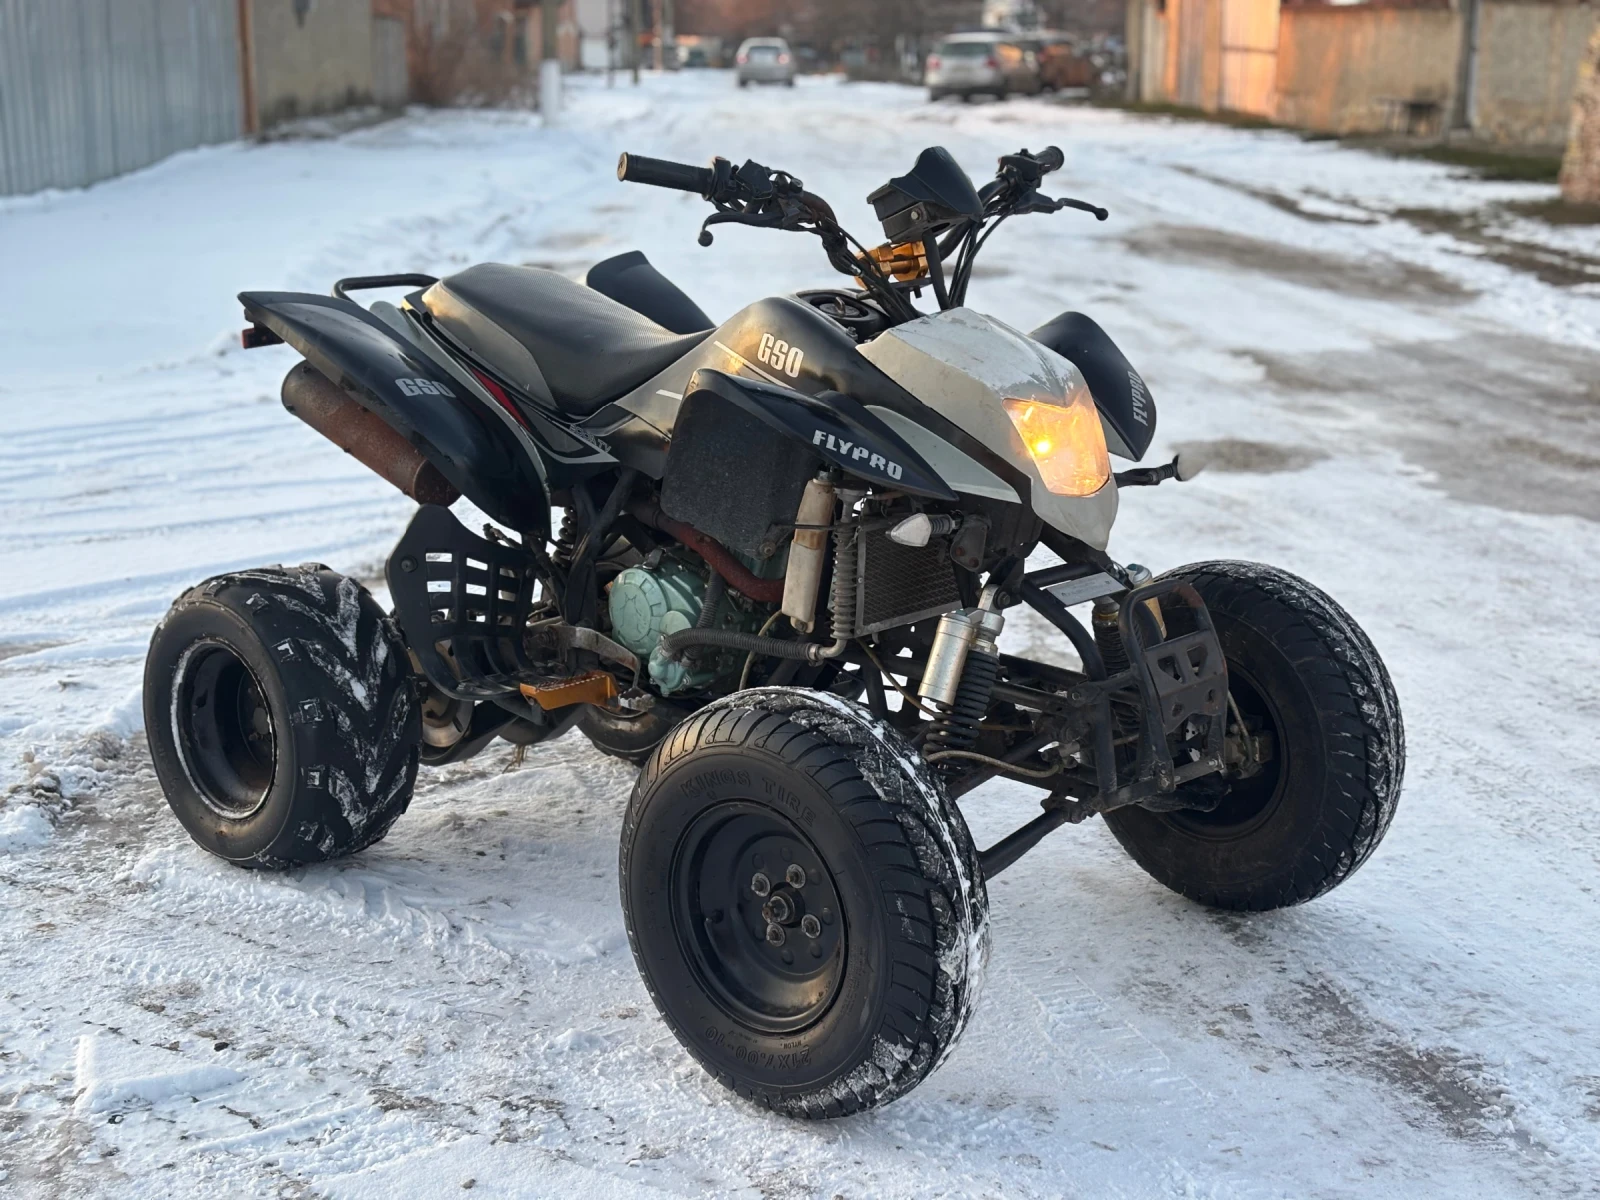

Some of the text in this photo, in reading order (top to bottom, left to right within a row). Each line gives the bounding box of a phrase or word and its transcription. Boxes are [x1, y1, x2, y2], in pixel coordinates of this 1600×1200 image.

[1127, 371, 1149, 427] FLYPRO
[812, 429, 903, 480] FLYPRO
[680, 768, 817, 828] KINGS TIRE
